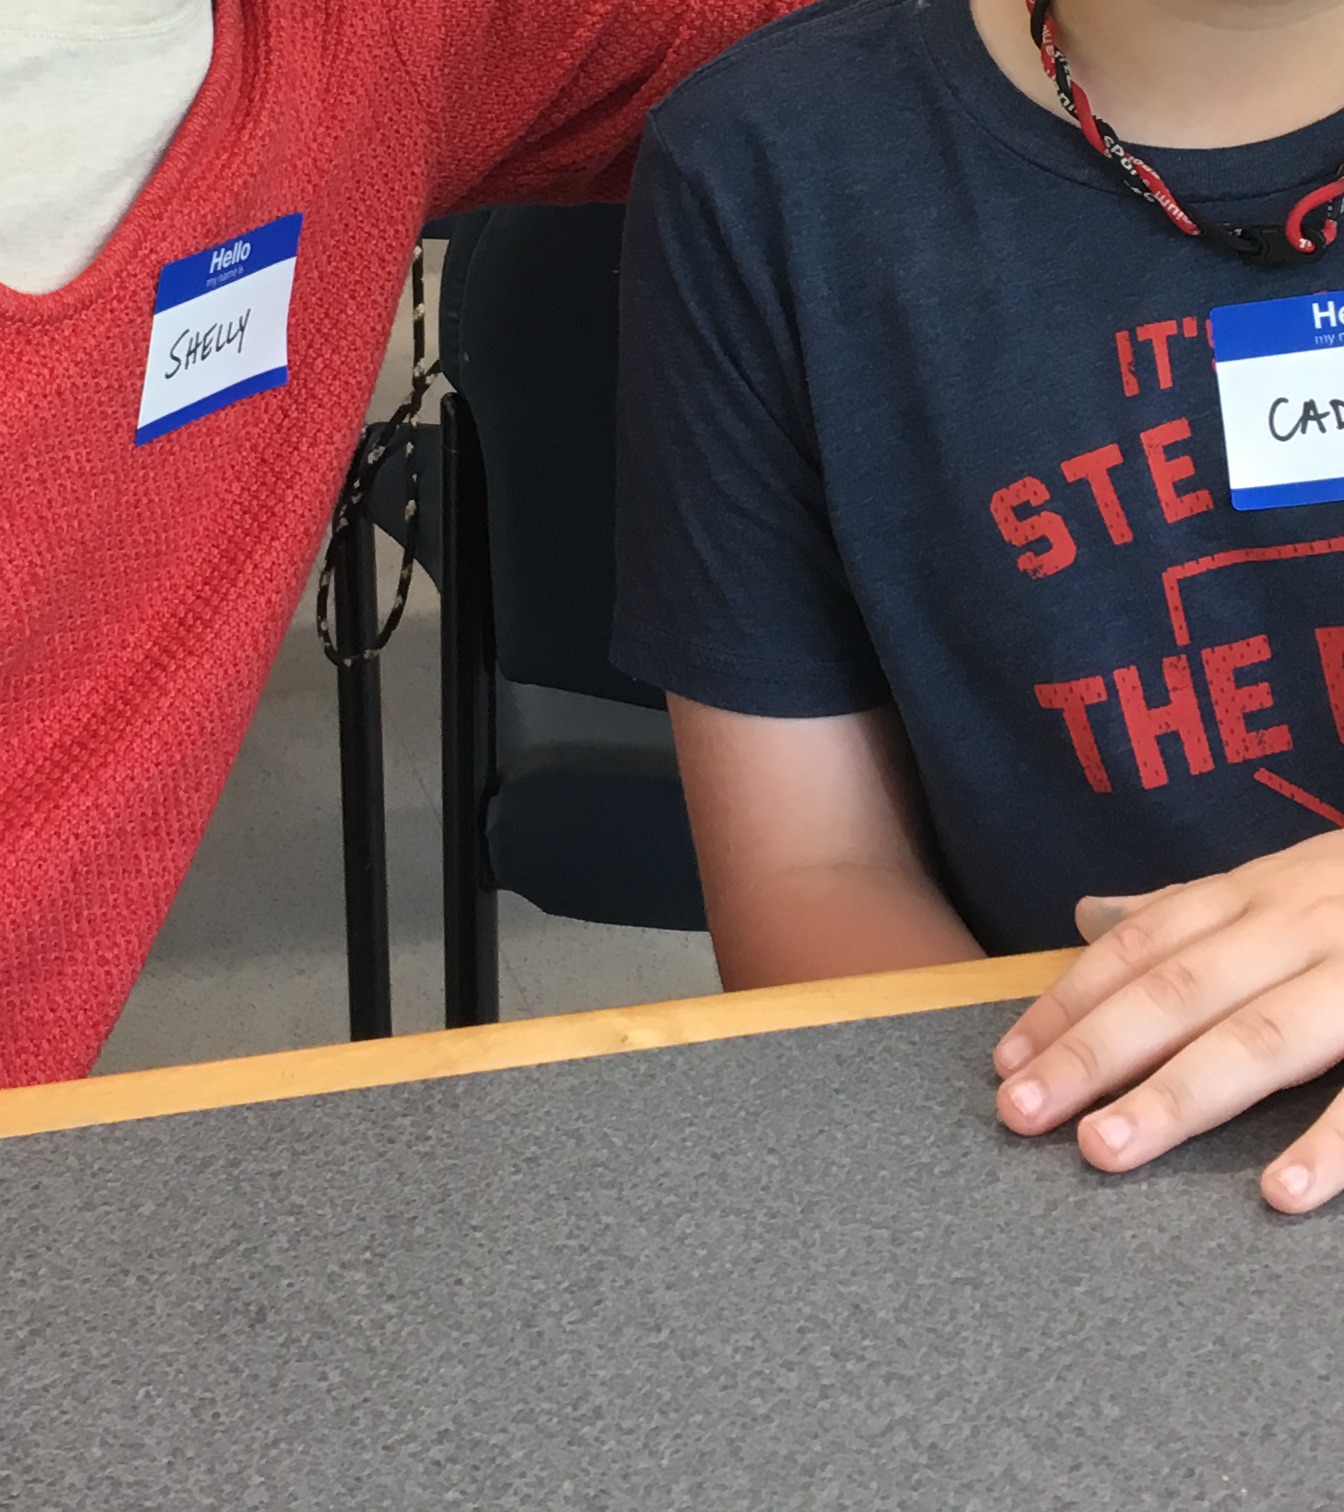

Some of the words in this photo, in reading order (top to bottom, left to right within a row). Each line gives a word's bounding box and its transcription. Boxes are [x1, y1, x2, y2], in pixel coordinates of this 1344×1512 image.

[209, 240, 251, 274] Hello
[165, 308, 251, 379] SHELLY
[1115, 316, 1217, 398] IT'
[1314, 334, 1336, 346] my
[1034, 634, 1294, 793] THE
